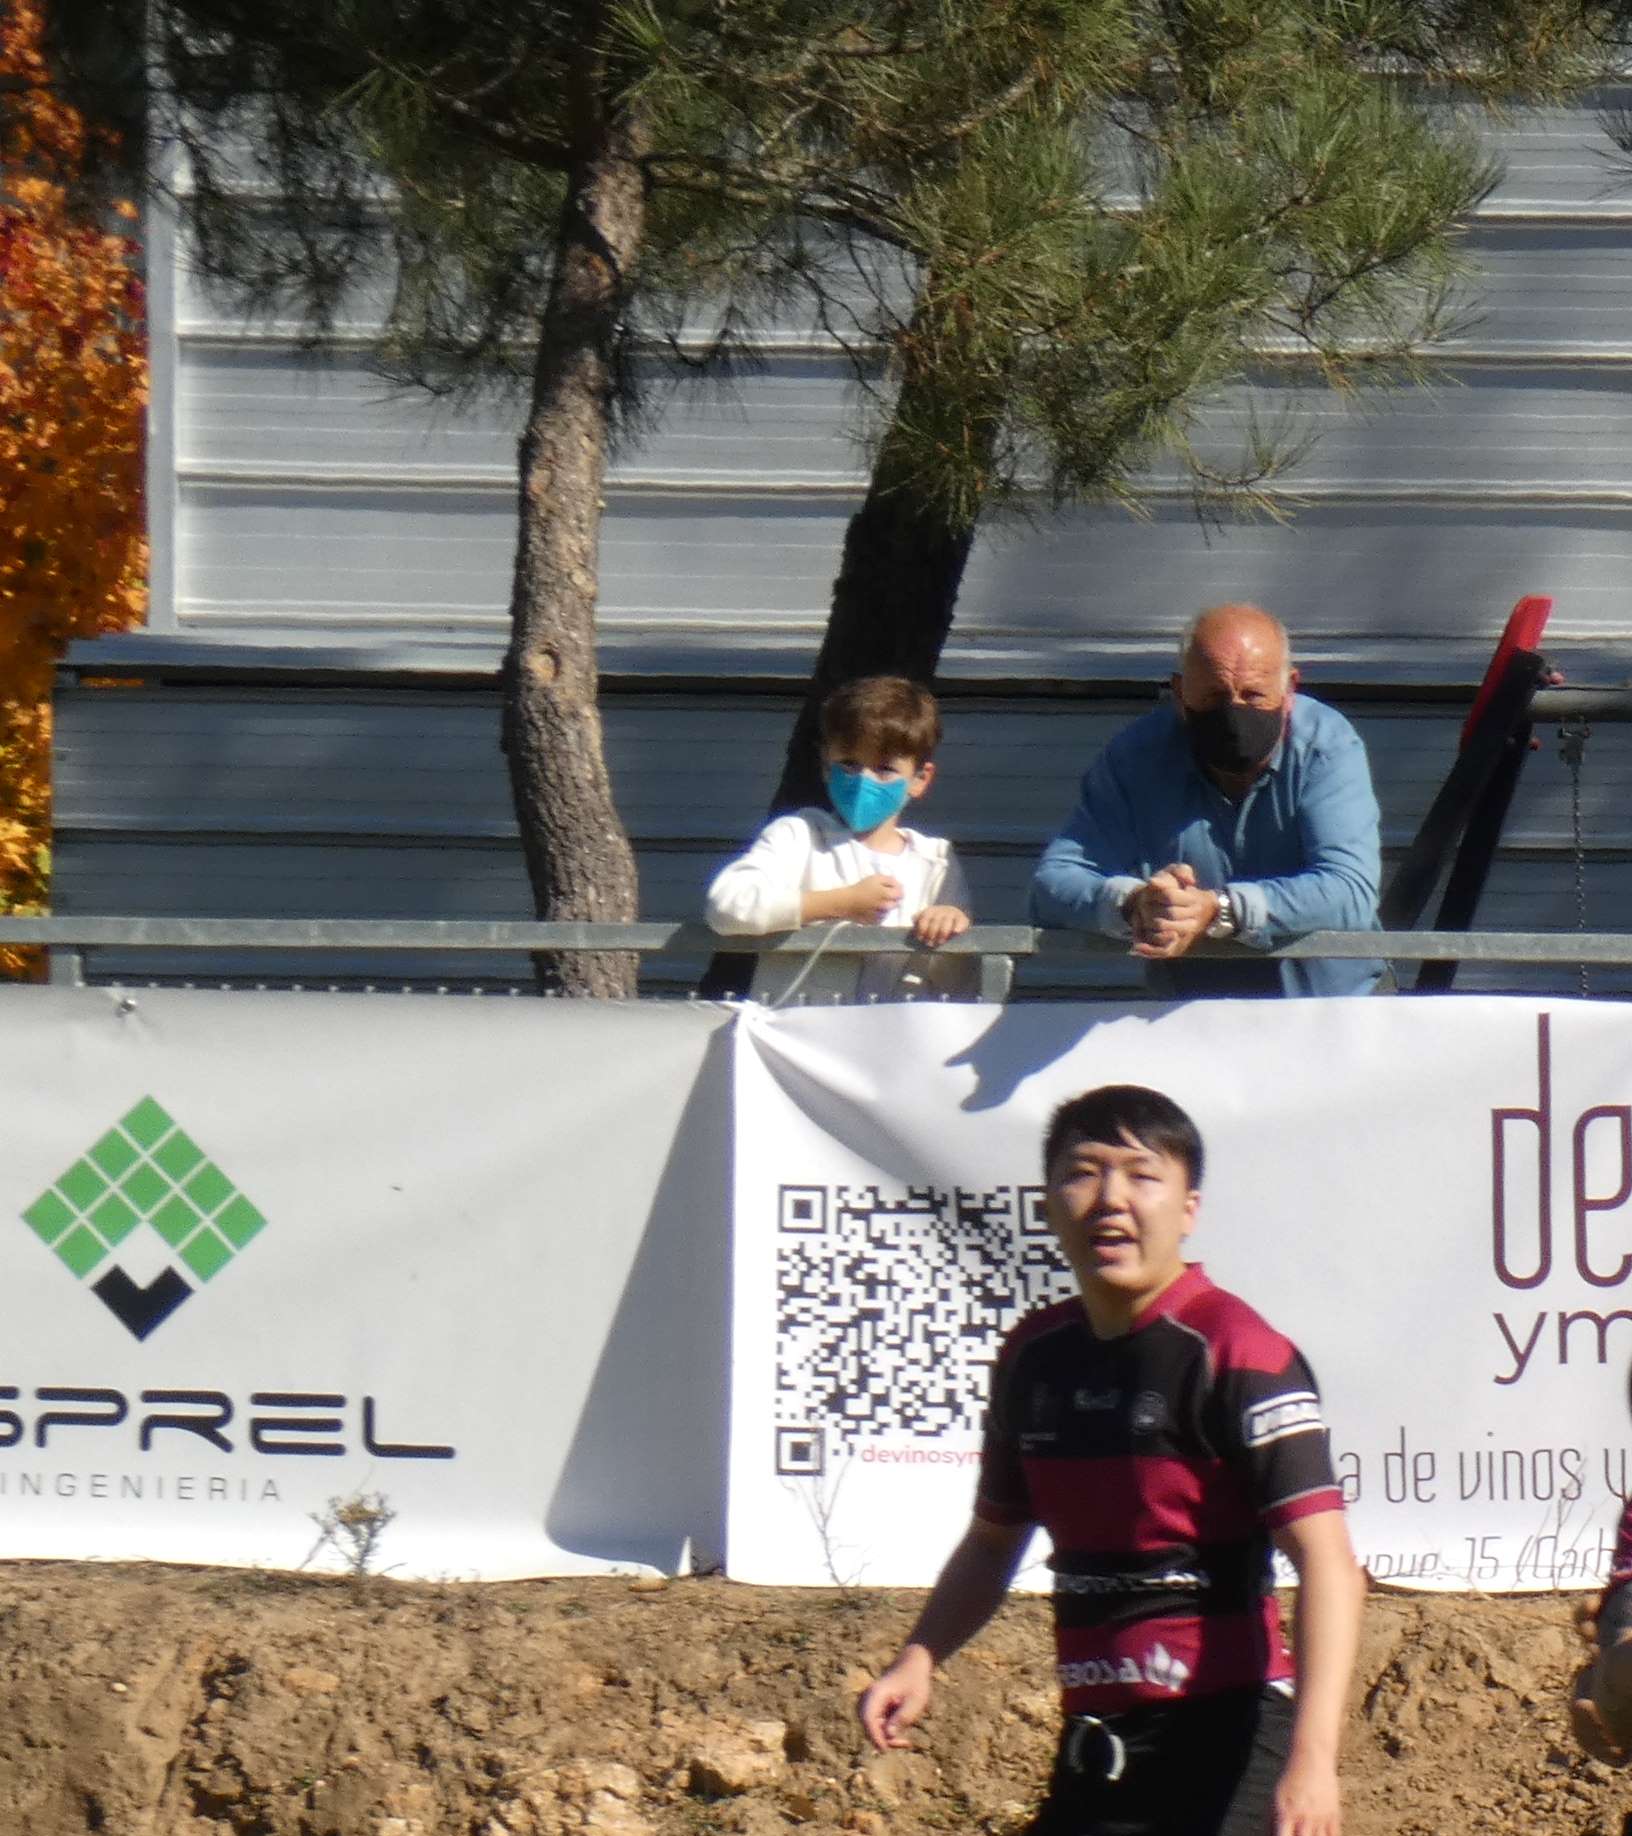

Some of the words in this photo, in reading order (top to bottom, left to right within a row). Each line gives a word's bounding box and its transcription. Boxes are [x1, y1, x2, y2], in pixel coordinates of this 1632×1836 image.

[0, 1386, 456, 1460] PREL
[1384, 1425, 1437, 1503] de
[1458, 1432, 1583, 1502] vinos
